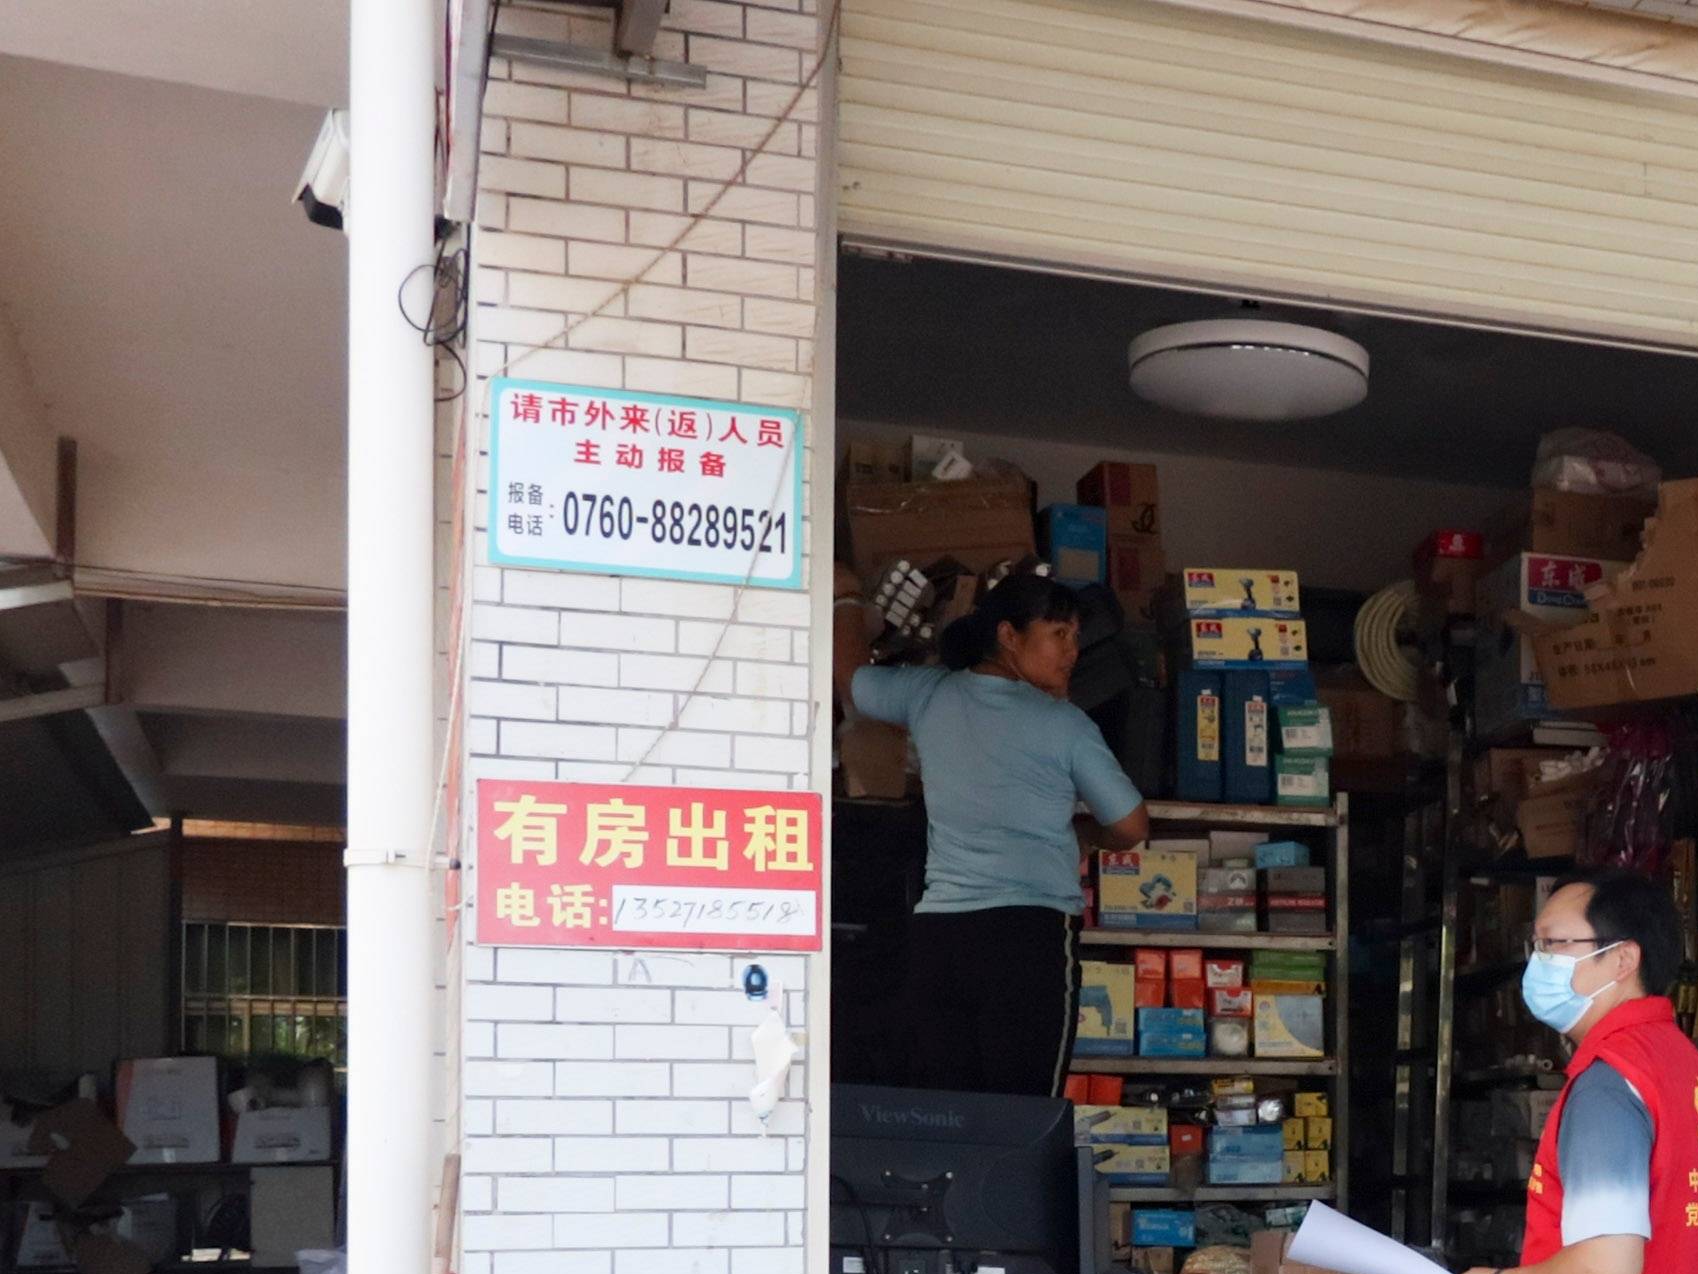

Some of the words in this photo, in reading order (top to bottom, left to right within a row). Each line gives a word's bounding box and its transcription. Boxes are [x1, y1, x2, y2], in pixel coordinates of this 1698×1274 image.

[510, 393, 785, 449] 请市外来(返)人员
[574, 440, 726, 478] 主动报备
[508, 481, 544, 507] 报备
[563, 490, 786, 555] 0760-88289521
[493, 795, 814, 873] 有房出租
[495, 882, 608, 930] 电话:
[858, 1103, 963, 1129] ViewSonic
